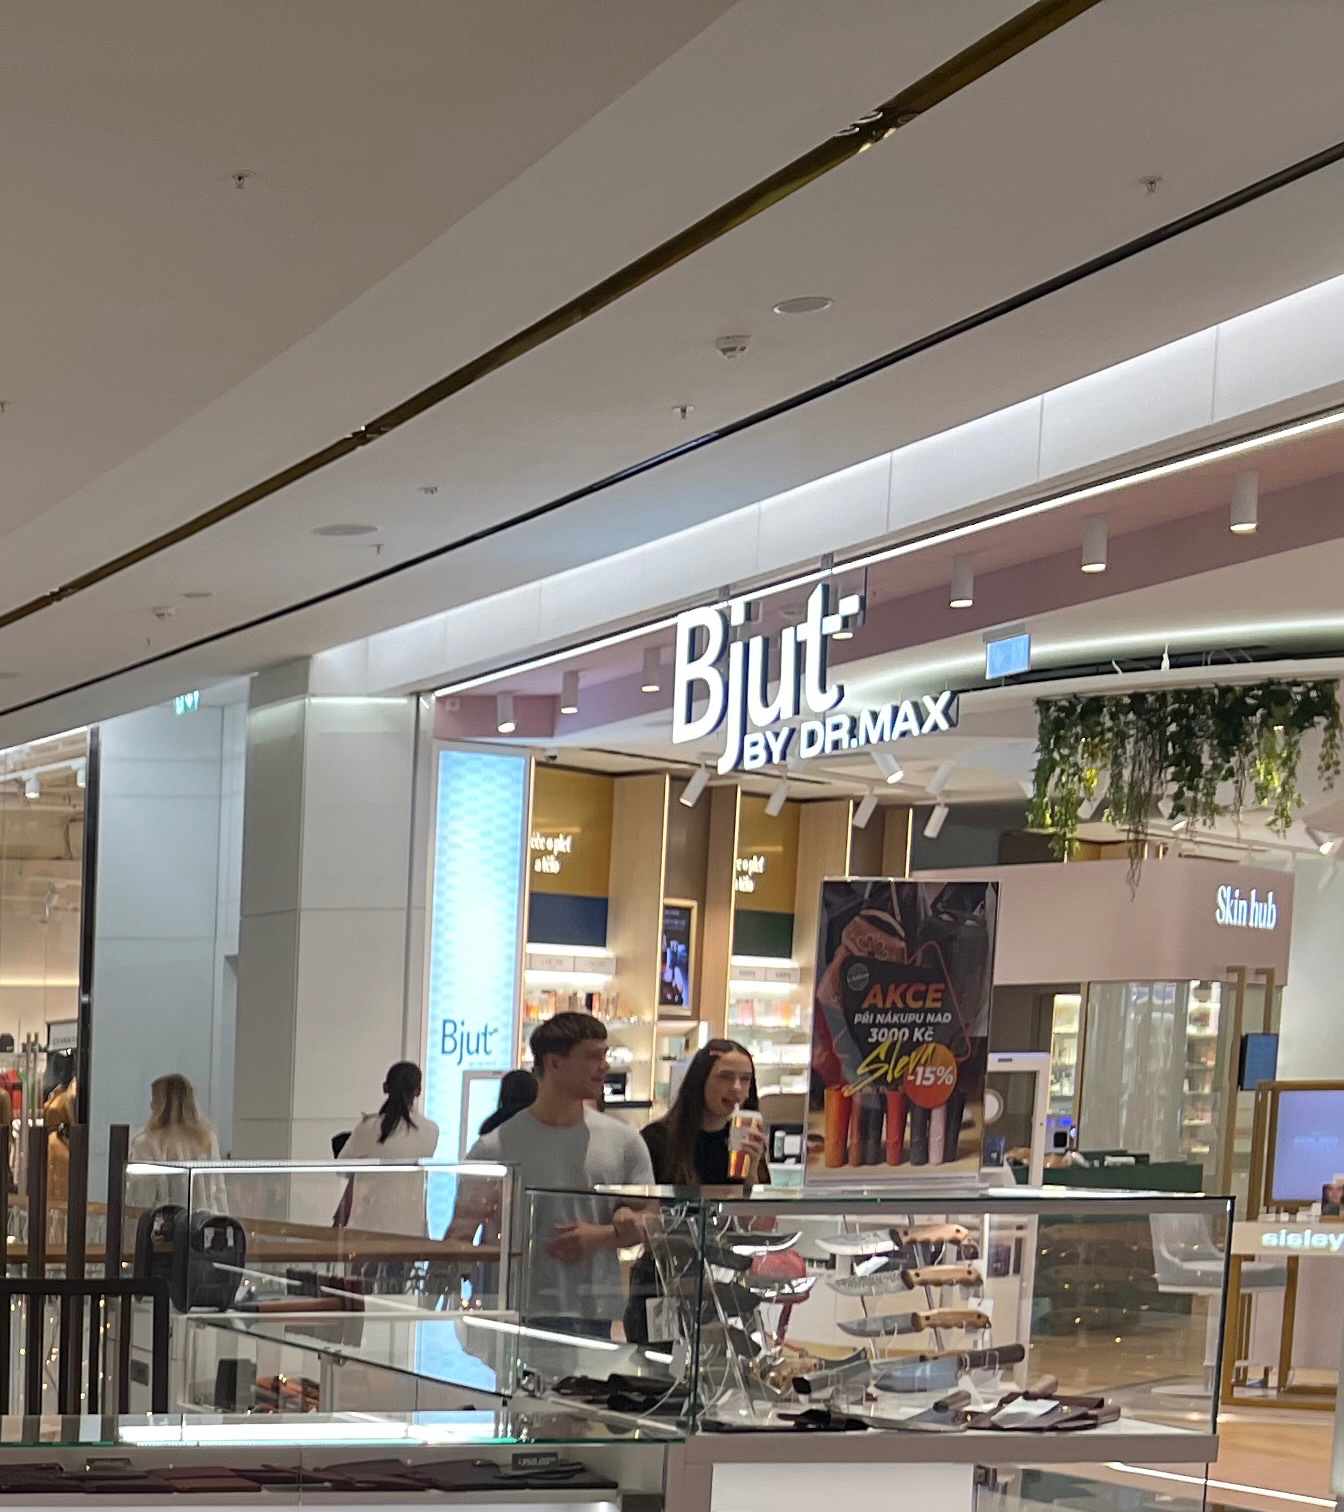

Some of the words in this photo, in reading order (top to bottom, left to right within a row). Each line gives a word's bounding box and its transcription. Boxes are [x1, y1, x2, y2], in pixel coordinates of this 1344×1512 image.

[673, 583, 860, 775] Bjut
[744, 727, 795, 770] BY
[799, 690, 954, 759] DR.MAX
[1216, 885, 1247, 926] Skin
[1249, 888, 1277, 930] hub
[854, 1011, 874, 1024] PŘI
[876, 1010, 924, 1024] NÁKUPU
[926, 1012, 952, 1024] NAD
[863, 983, 945, 1009] AKCE
[441, 1018, 499, 1066] Bjut
[868, 1027, 909, 1043] 3000
[913, 1026, 934, 1042] Kč
